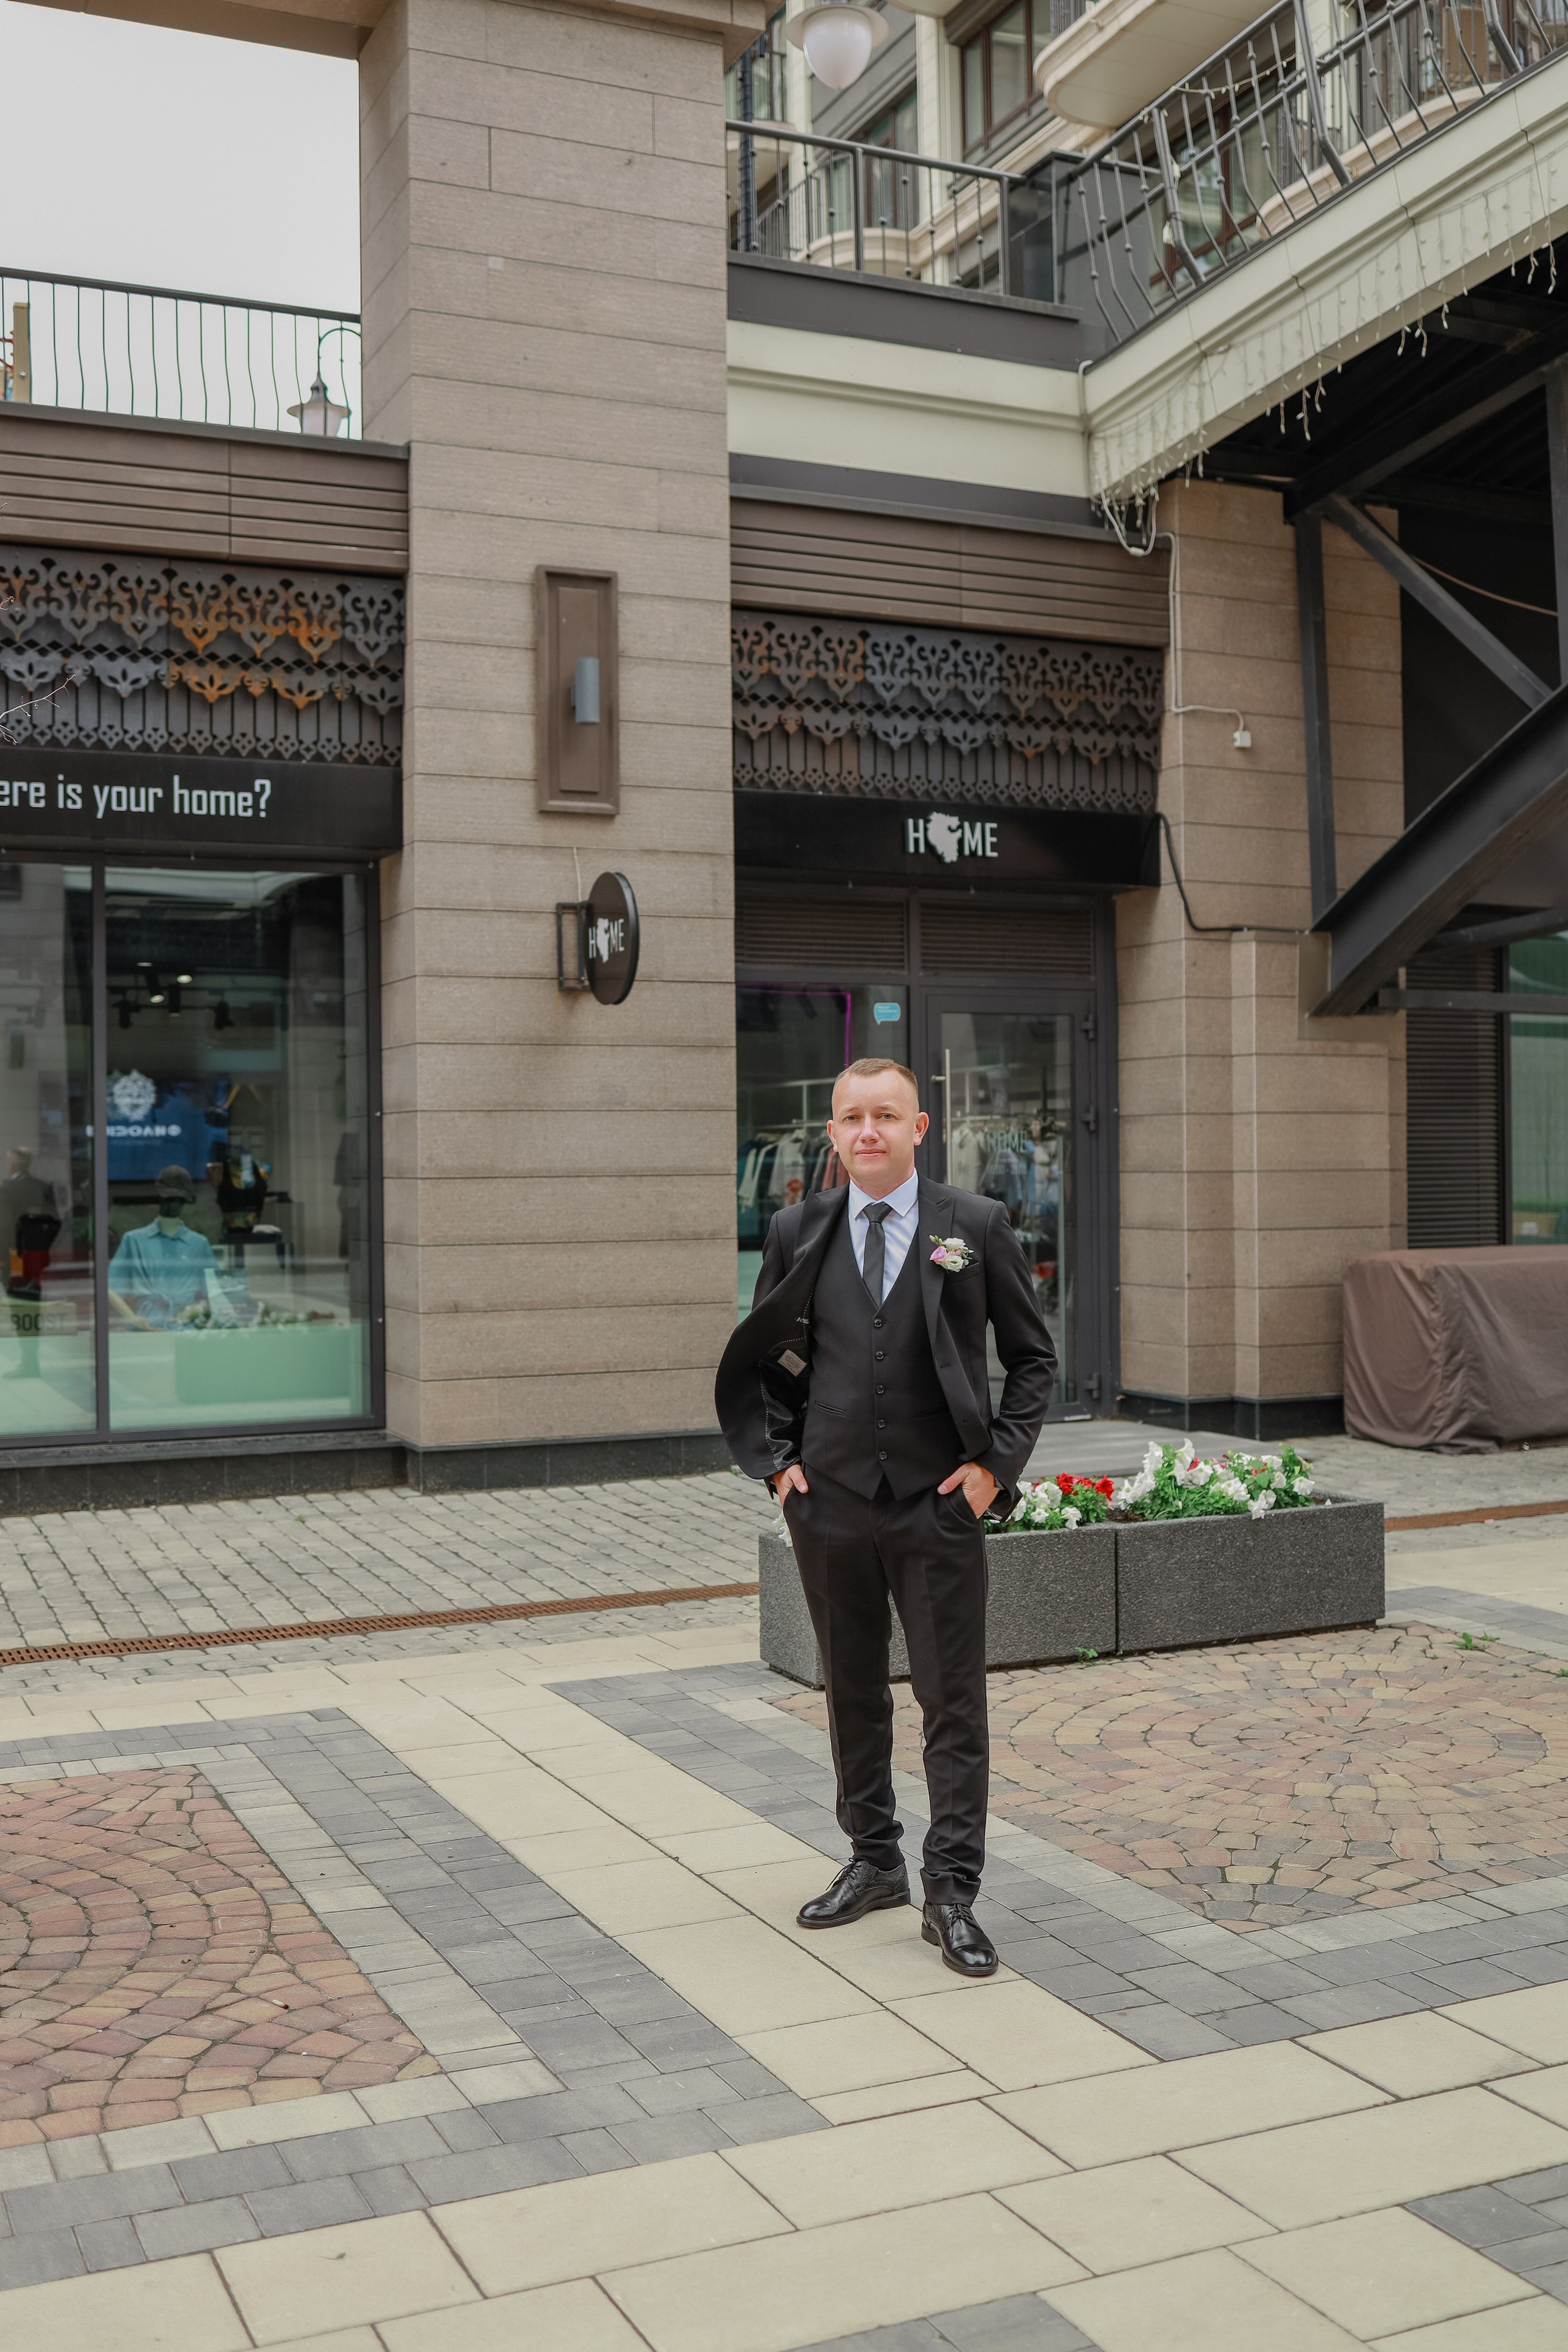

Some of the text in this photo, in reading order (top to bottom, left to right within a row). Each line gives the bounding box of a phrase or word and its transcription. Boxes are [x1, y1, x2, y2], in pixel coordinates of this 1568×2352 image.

[58, 774, 82, 809] is
[93, 785, 163, 819] your
[173, 775, 271, 818] home?
